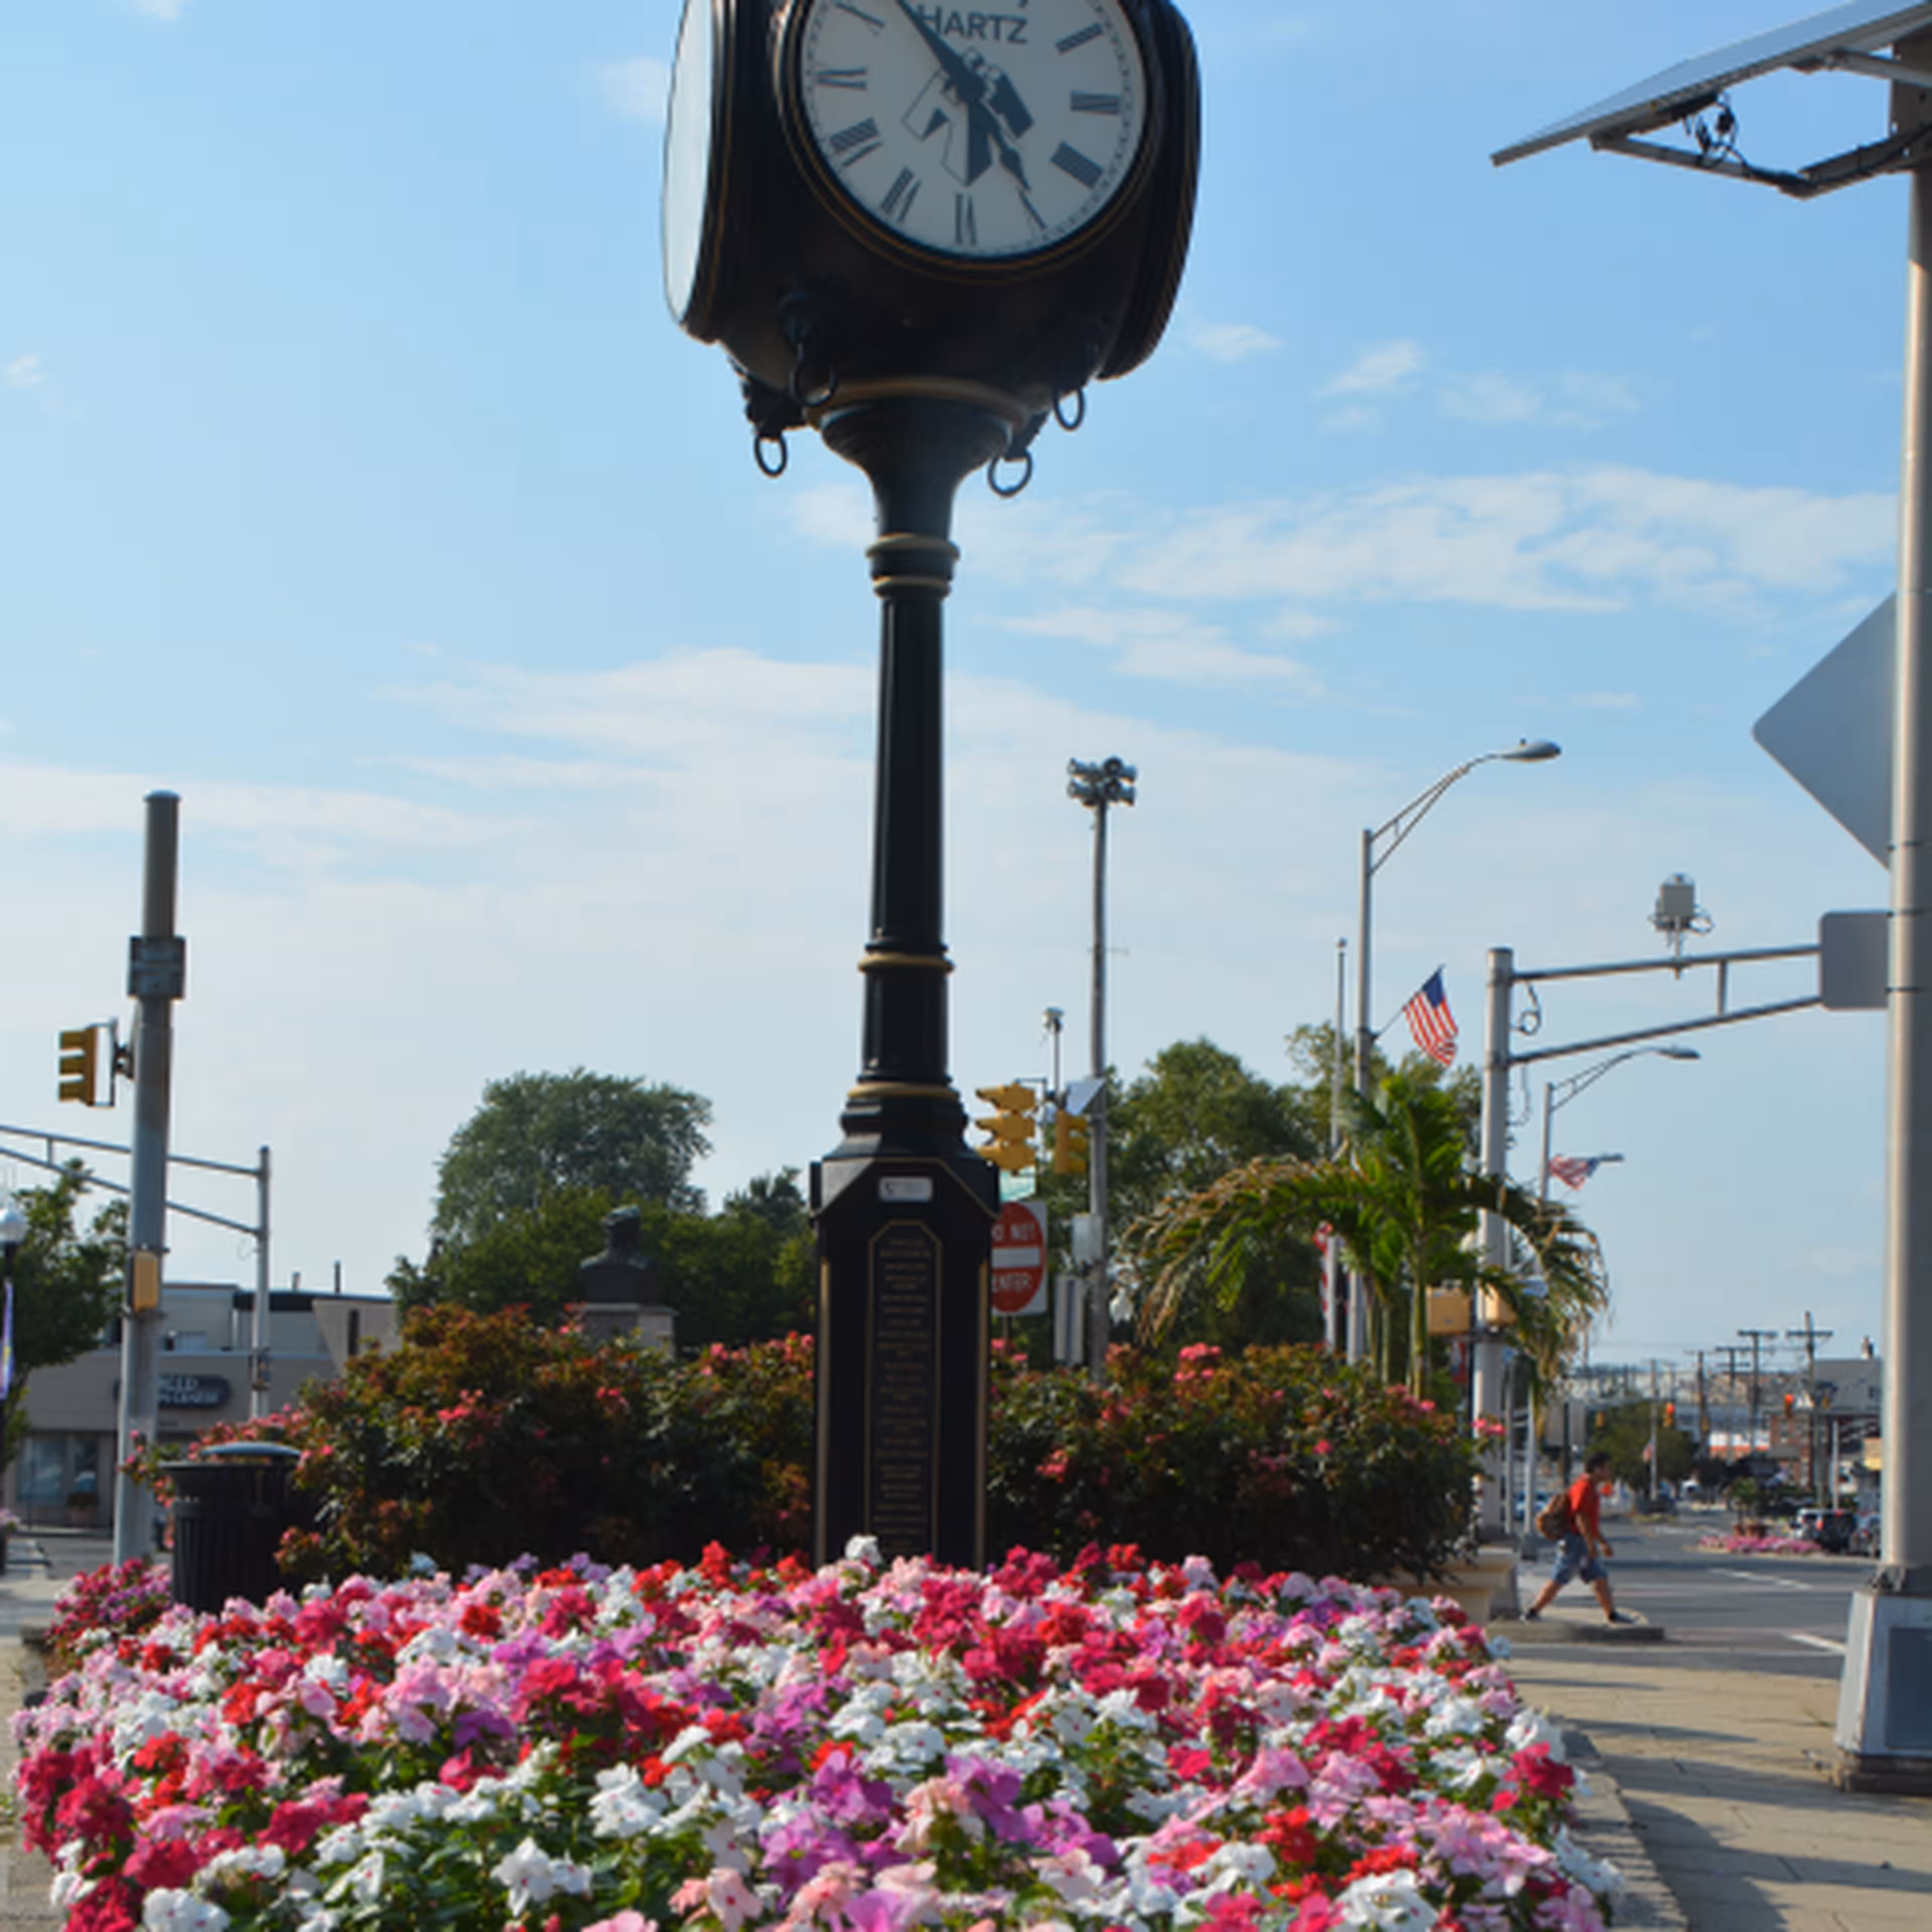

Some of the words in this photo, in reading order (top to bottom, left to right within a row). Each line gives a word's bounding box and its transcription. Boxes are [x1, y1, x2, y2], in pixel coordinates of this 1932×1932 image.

[917, 4, 1028, 44] HARTZ
[1010, 1222, 1036, 1241] NOT
[991, 1271, 1033, 1294] ENTER
